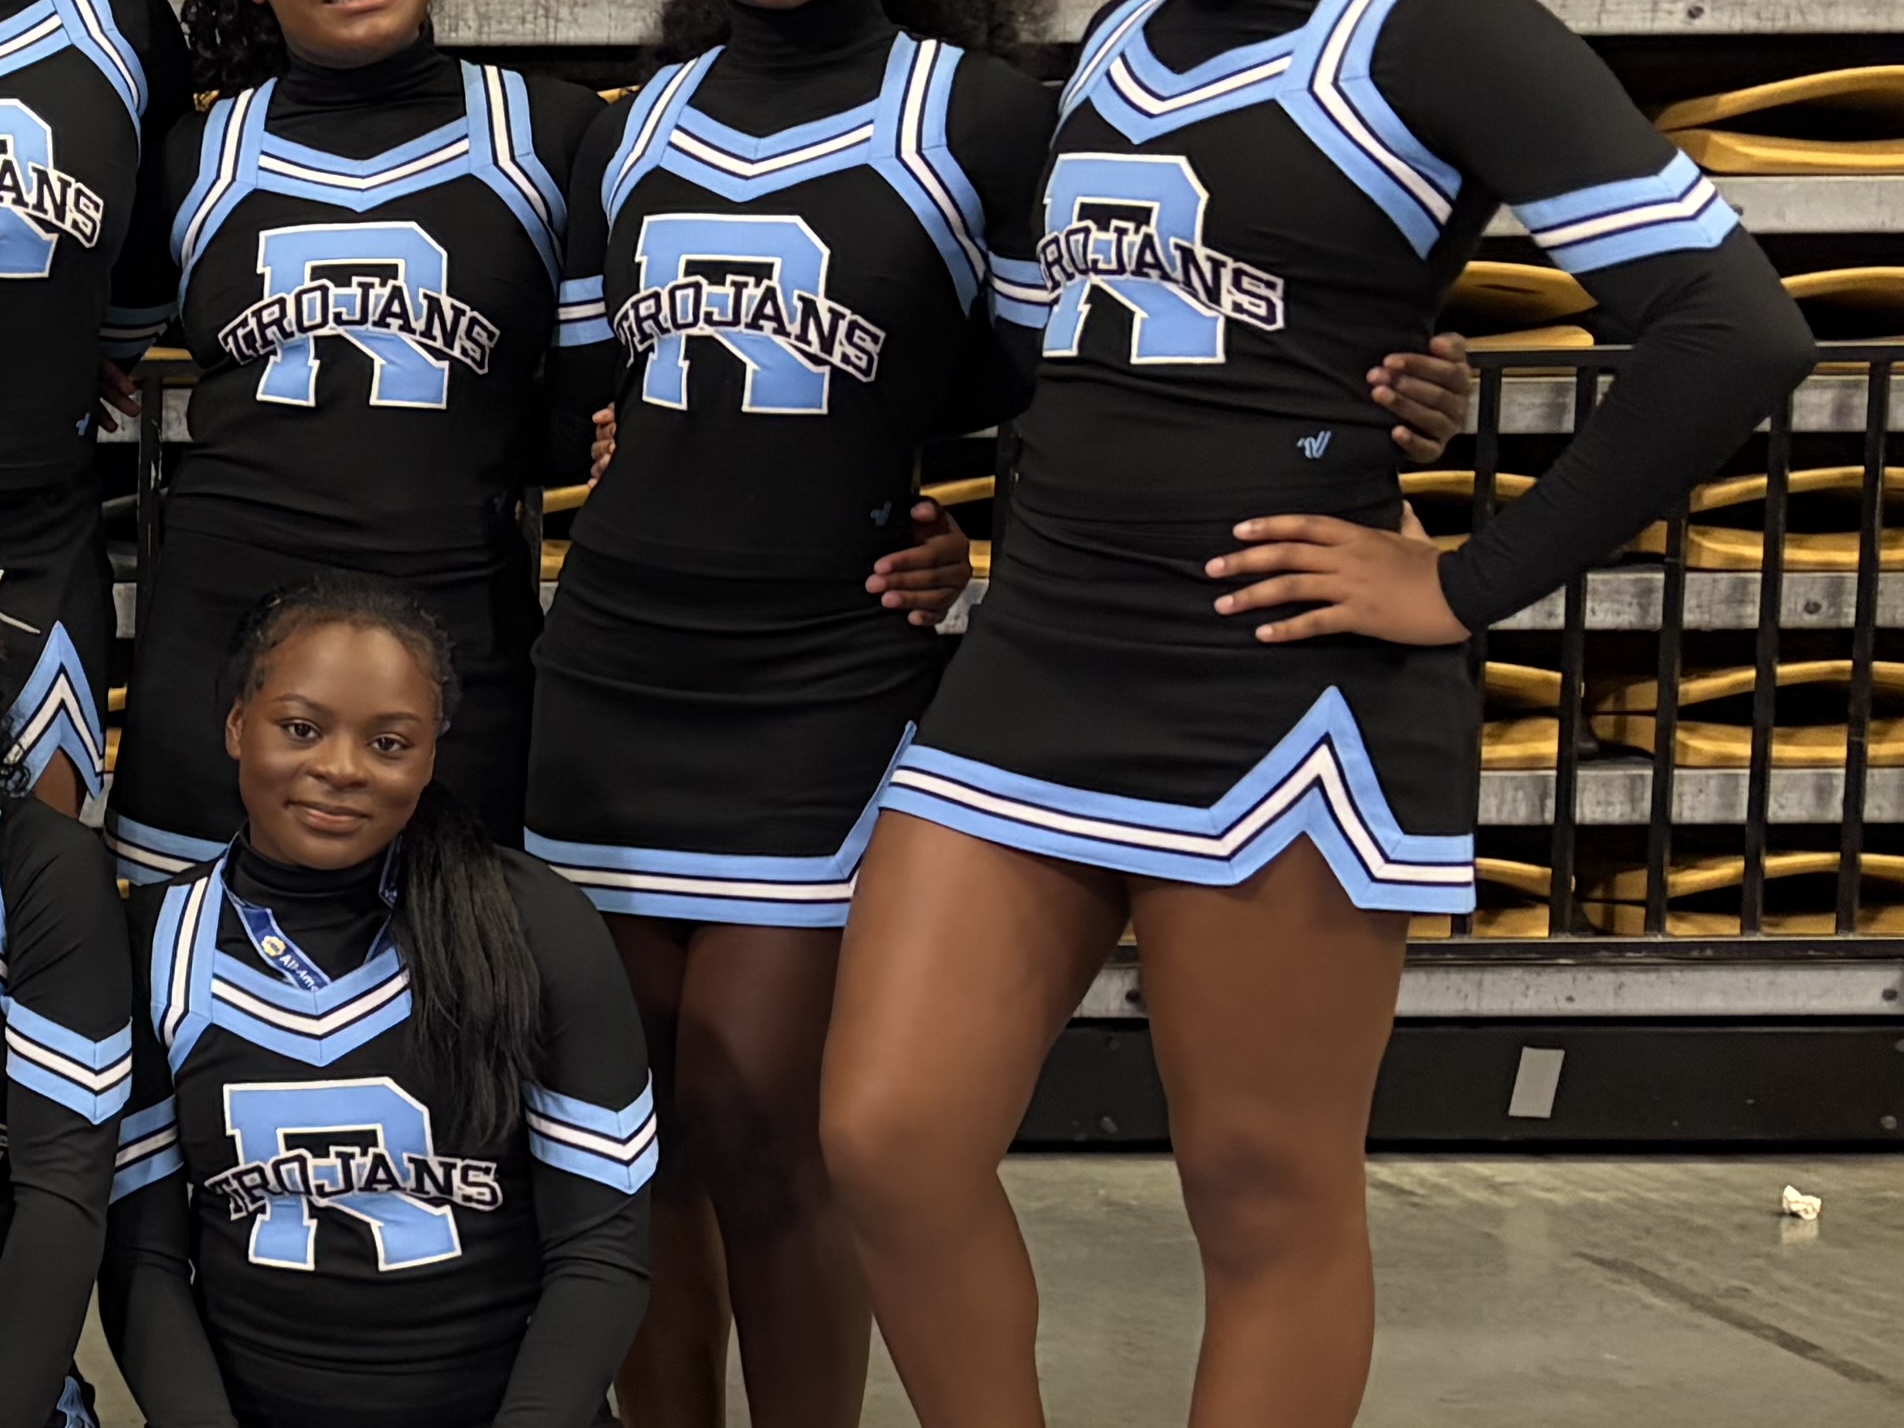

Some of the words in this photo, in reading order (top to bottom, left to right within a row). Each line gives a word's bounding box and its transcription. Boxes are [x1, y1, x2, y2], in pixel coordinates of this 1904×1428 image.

[217, 276, 501, 376] TROJANS
[256, 221, 449, 410] R
[634, 213, 831, 415] R
[1037, 220, 1285, 331] ROJANS
[204, 1147, 503, 1221] TROJANS
[223, 1077, 462, 1271] R
